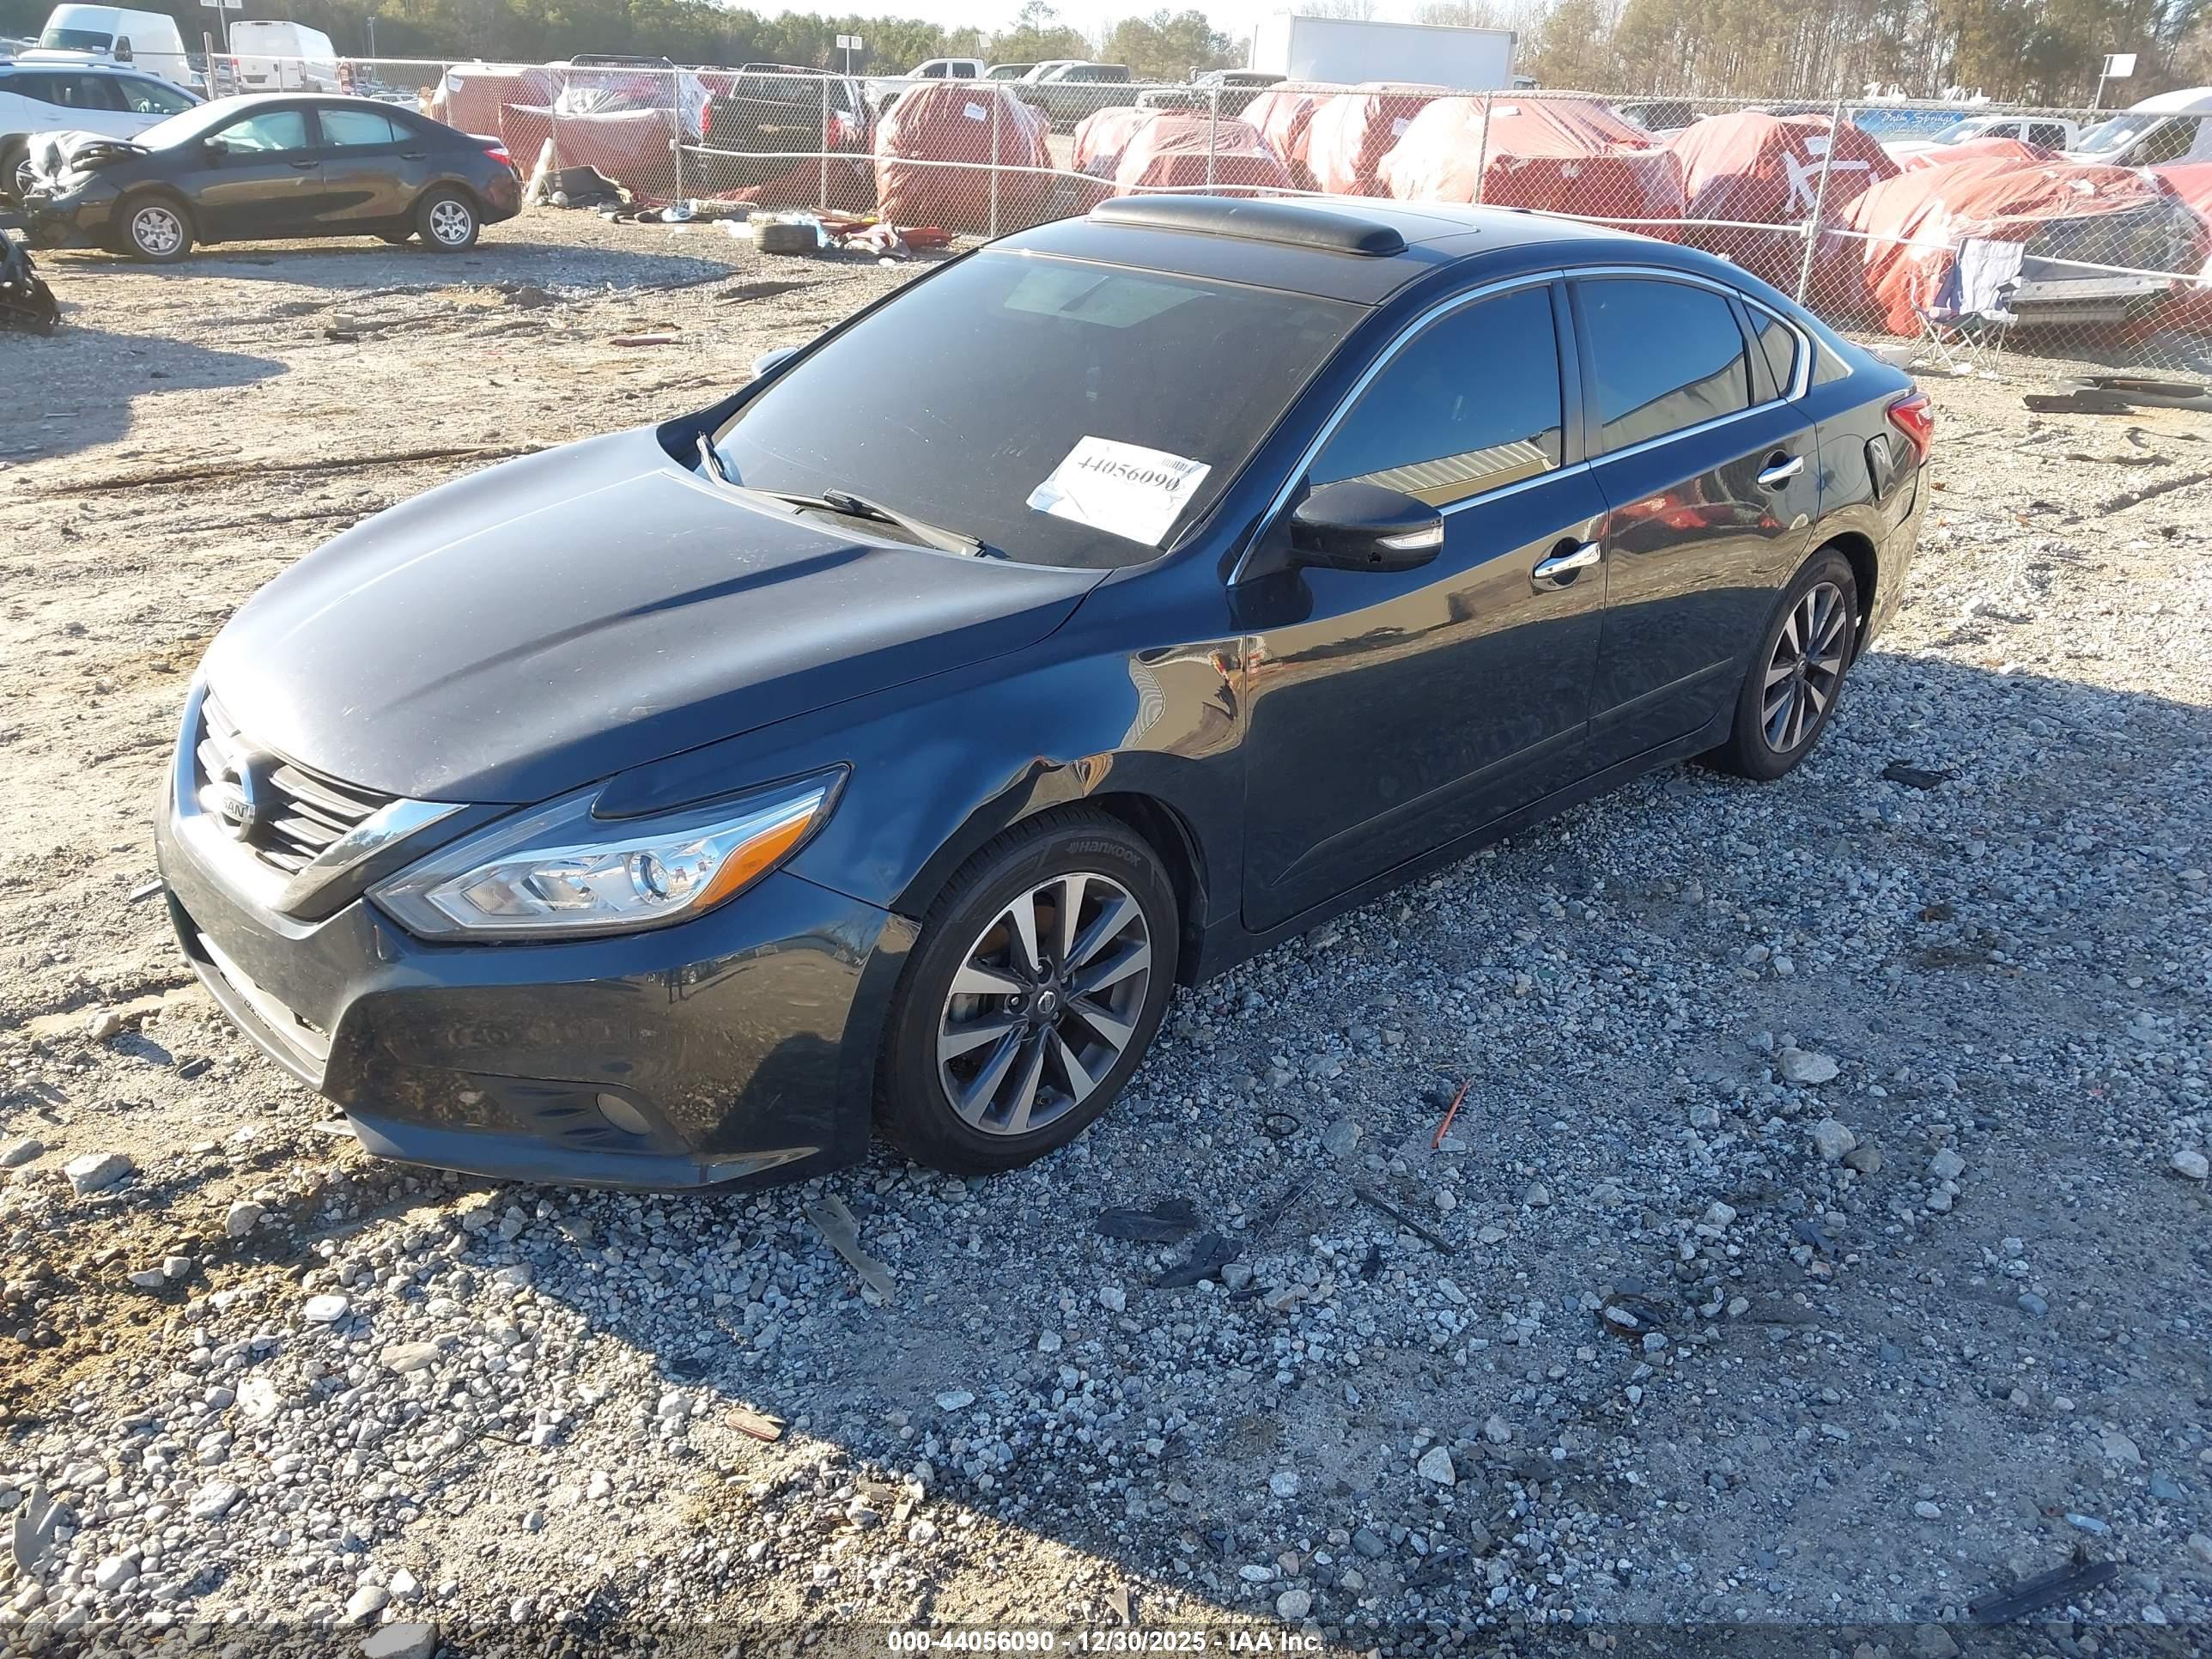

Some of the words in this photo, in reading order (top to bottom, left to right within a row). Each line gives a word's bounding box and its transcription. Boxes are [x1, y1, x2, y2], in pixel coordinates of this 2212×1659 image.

[1881, 112, 1908, 124] Palm
[1911, 112, 1954, 125] Springs
[1077, 455, 1182, 493] 44056090
